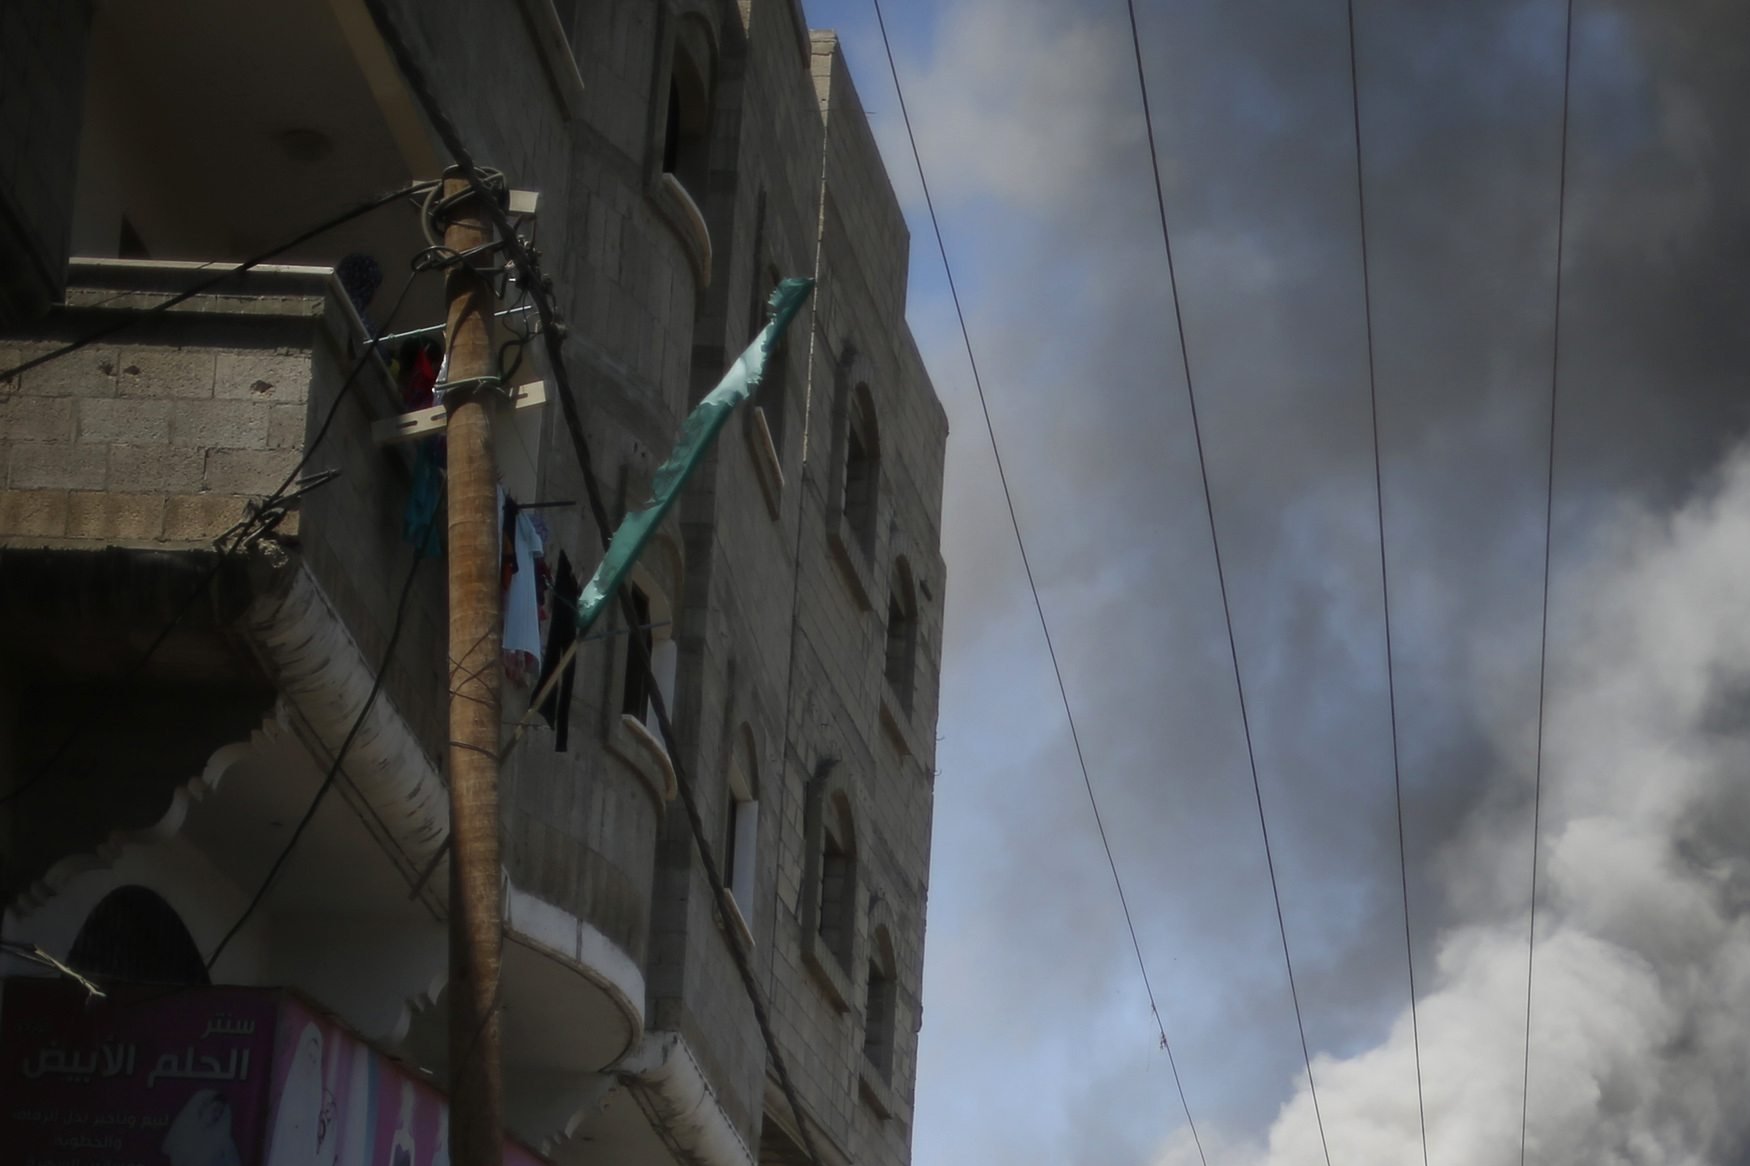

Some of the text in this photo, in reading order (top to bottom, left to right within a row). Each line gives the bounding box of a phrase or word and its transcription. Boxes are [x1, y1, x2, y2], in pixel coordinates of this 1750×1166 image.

[200, 1012, 257, 1041] سنتر
[20, 1034, 251, 1089] الحلم الأبيض
